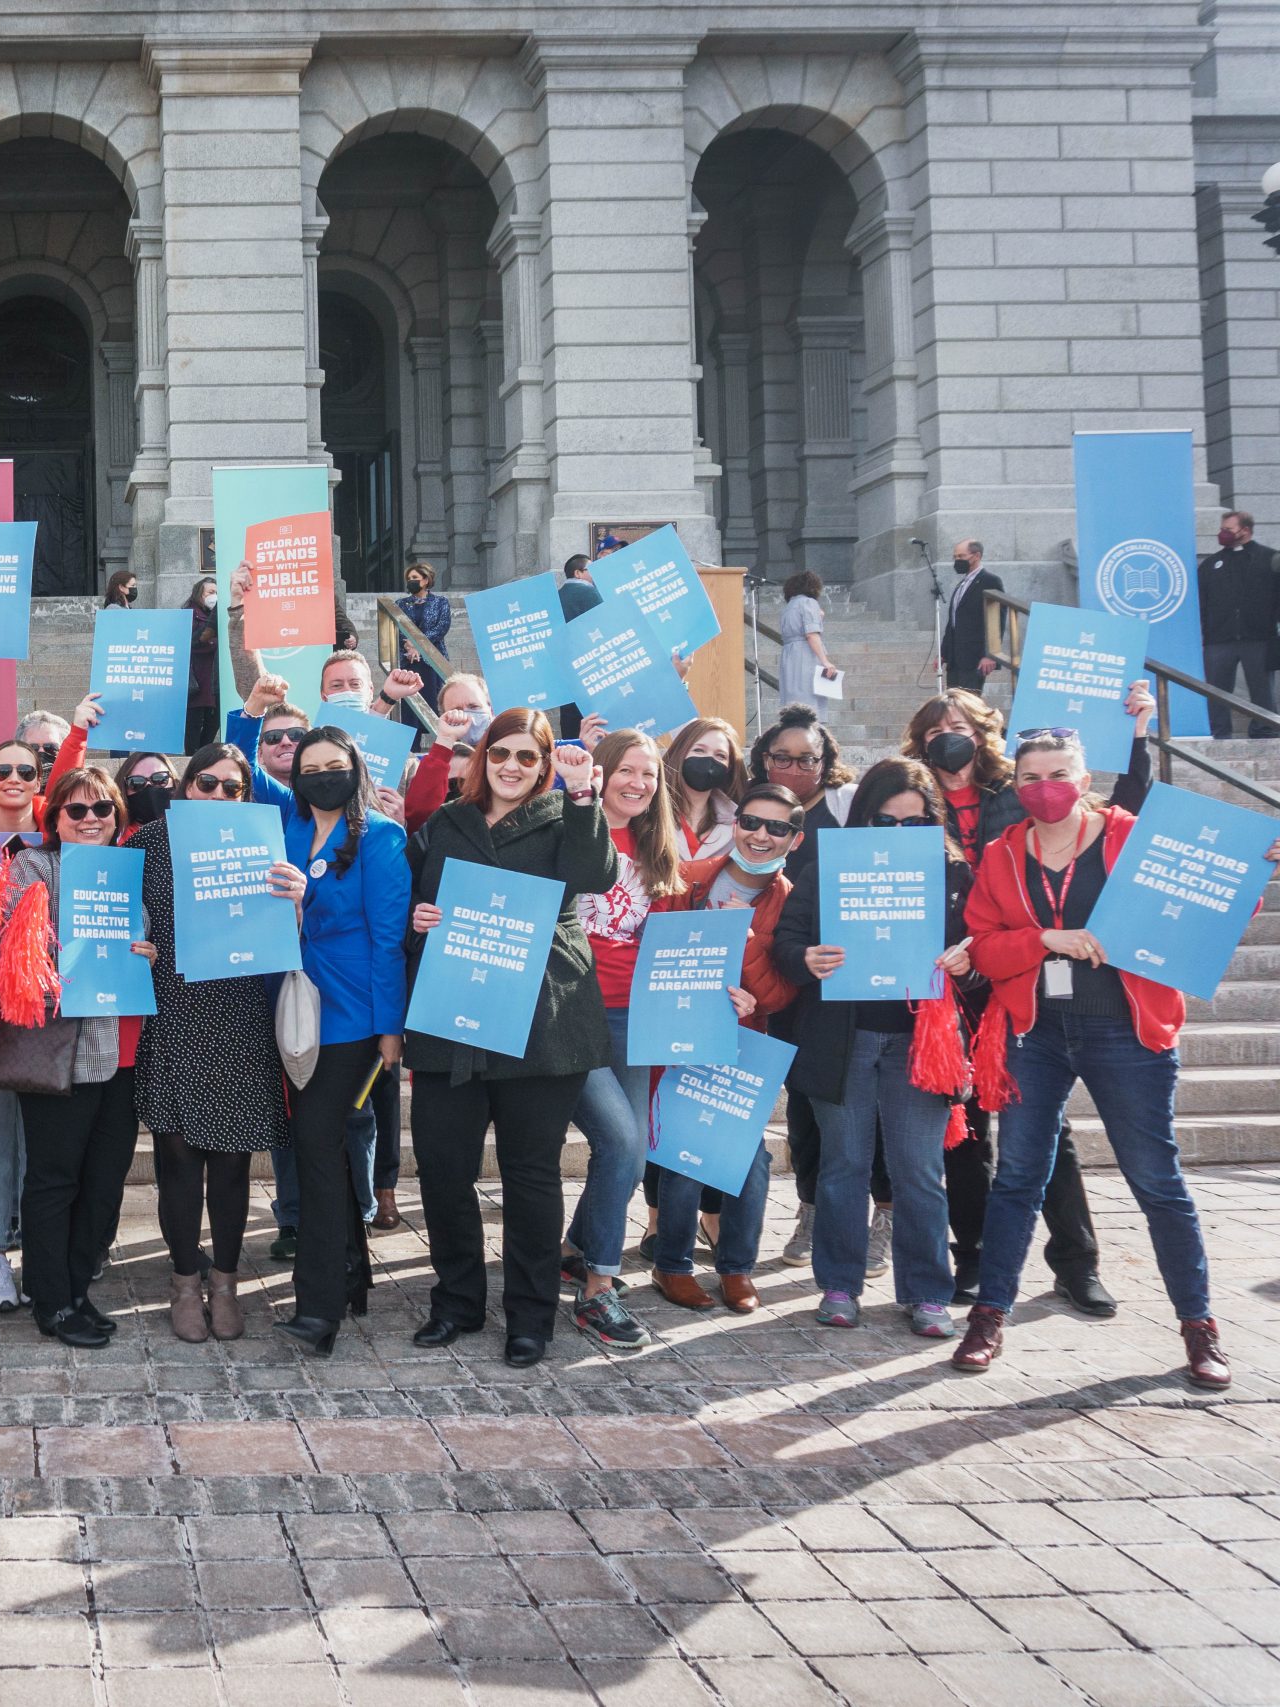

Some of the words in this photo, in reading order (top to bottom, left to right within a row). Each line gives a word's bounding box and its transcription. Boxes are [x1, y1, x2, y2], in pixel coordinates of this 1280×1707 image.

[257, 536, 317, 551] COLORADO
[256, 547, 318, 563] STANDS
[276, 562, 298, 570] WITH
[257, 570, 318, 587] PUBLIC
[258, 585, 320, 599] WORKERS
[636, 577, 686, 606] LLECTIVE
[640, 586, 689, 615] RGAINING
[487, 609, 548, 633] EDUCATORS
[511, 626, 528, 636] FOR
[108, 645, 174, 654] EDUCATORS
[572, 627, 637, 669] EDUCATORS
[599, 650, 618, 664] FOR
[1043, 645, 1125, 666] EDUCATORS
[106, 665, 172, 674] COLLECTIVE
[582, 645, 647, 686] COLLECTIVE
[1072, 661, 1094, 671] FOR
[105, 676, 172, 685] BARGAINING
[587, 655, 653, 695] BARGAINING
[1038, 667, 1122, 688] COLLECTIVE
[1036, 680, 1120, 700] BARGAINING
[190, 845, 269, 863] EDUCATORS
[1150, 833, 1249, 875] EDUCATORS
[221, 861, 242, 871] FOR
[1179, 859, 1207, 874] FOR
[839, 871, 925, 883] EDUCATORS
[1138, 859, 1237, 900] COLLECTIVE
[72, 889, 128, 903] EDUCATORS
[195, 882, 273, 901] BARGAINING
[871, 885, 893, 894] FOR
[1132, 872, 1230, 913] BARGAINING
[94, 904, 109, 912] FOR
[840, 897, 925, 908] COLLECTIVE
[72, 914, 129, 926] COLLECTIVE
[453, 907, 536, 934] EDUCATORS
[840, 910, 925, 920] BARGAINING
[72, 929, 129, 939] BARGAINING
[479, 926, 502, 938] FOR
[446, 931, 529, 959] COLLECTIVE
[443, 944, 526, 972] BARGAINING
[655, 947, 728, 958] EDUCATORS
[679, 959, 699, 967] FOR
[650, 969, 724, 979] COLLECTIVE
[647, 980, 723, 991] BARGAINING
[711, 1074, 733, 1087] FOR
[680, 1073, 757, 1110] COLLECTIVE
[674, 1084, 752, 1122] BARGAINING
